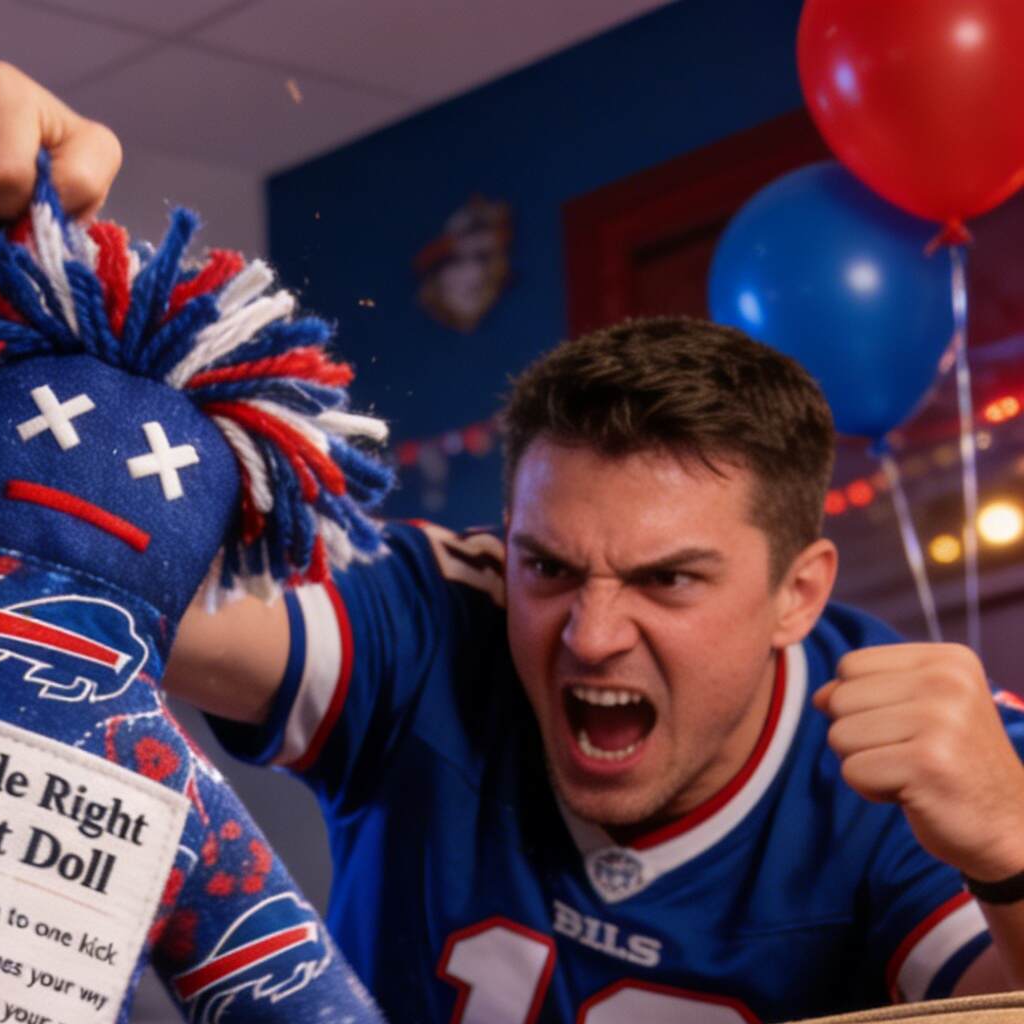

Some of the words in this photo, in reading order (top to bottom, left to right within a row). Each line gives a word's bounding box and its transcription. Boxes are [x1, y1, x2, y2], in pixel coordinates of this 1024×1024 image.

[36, 771, 150, 847] Right
[18, 825, 118, 896] Doll
[6, 907, 30, 930] to
[33, 921, 74, 948] one
[77, 932, 118, 966] kick
[25, 967, 76, 995] your
